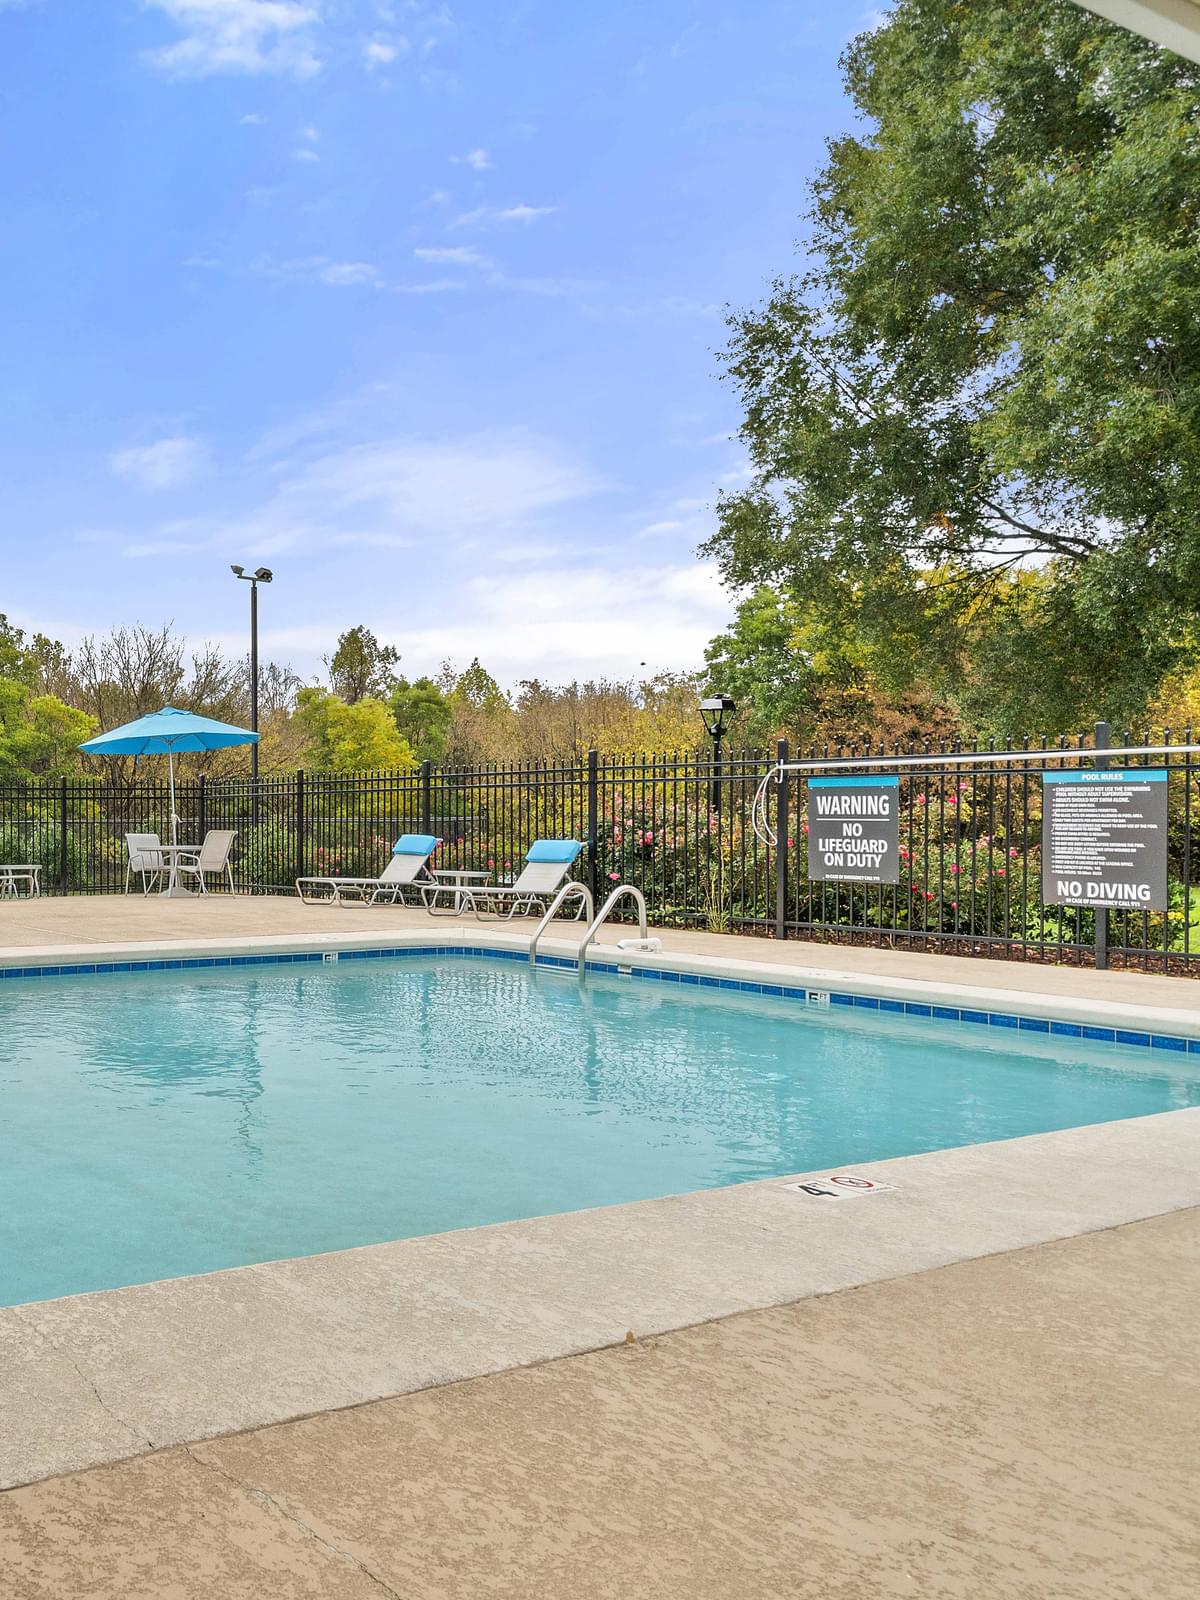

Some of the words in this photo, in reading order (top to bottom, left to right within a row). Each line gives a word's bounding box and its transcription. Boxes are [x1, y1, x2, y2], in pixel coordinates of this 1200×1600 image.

[816, 795, 890, 816] WARNING
[842, 823, 863, 837] NO
[818, 838, 888, 854] LIFEGUARD
[824, 853, 844, 867] ON
[847, 853, 882, 868] DUTY
[1057, 880, 1082, 897] NO
[1087, 882, 1151, 901] DIVING
